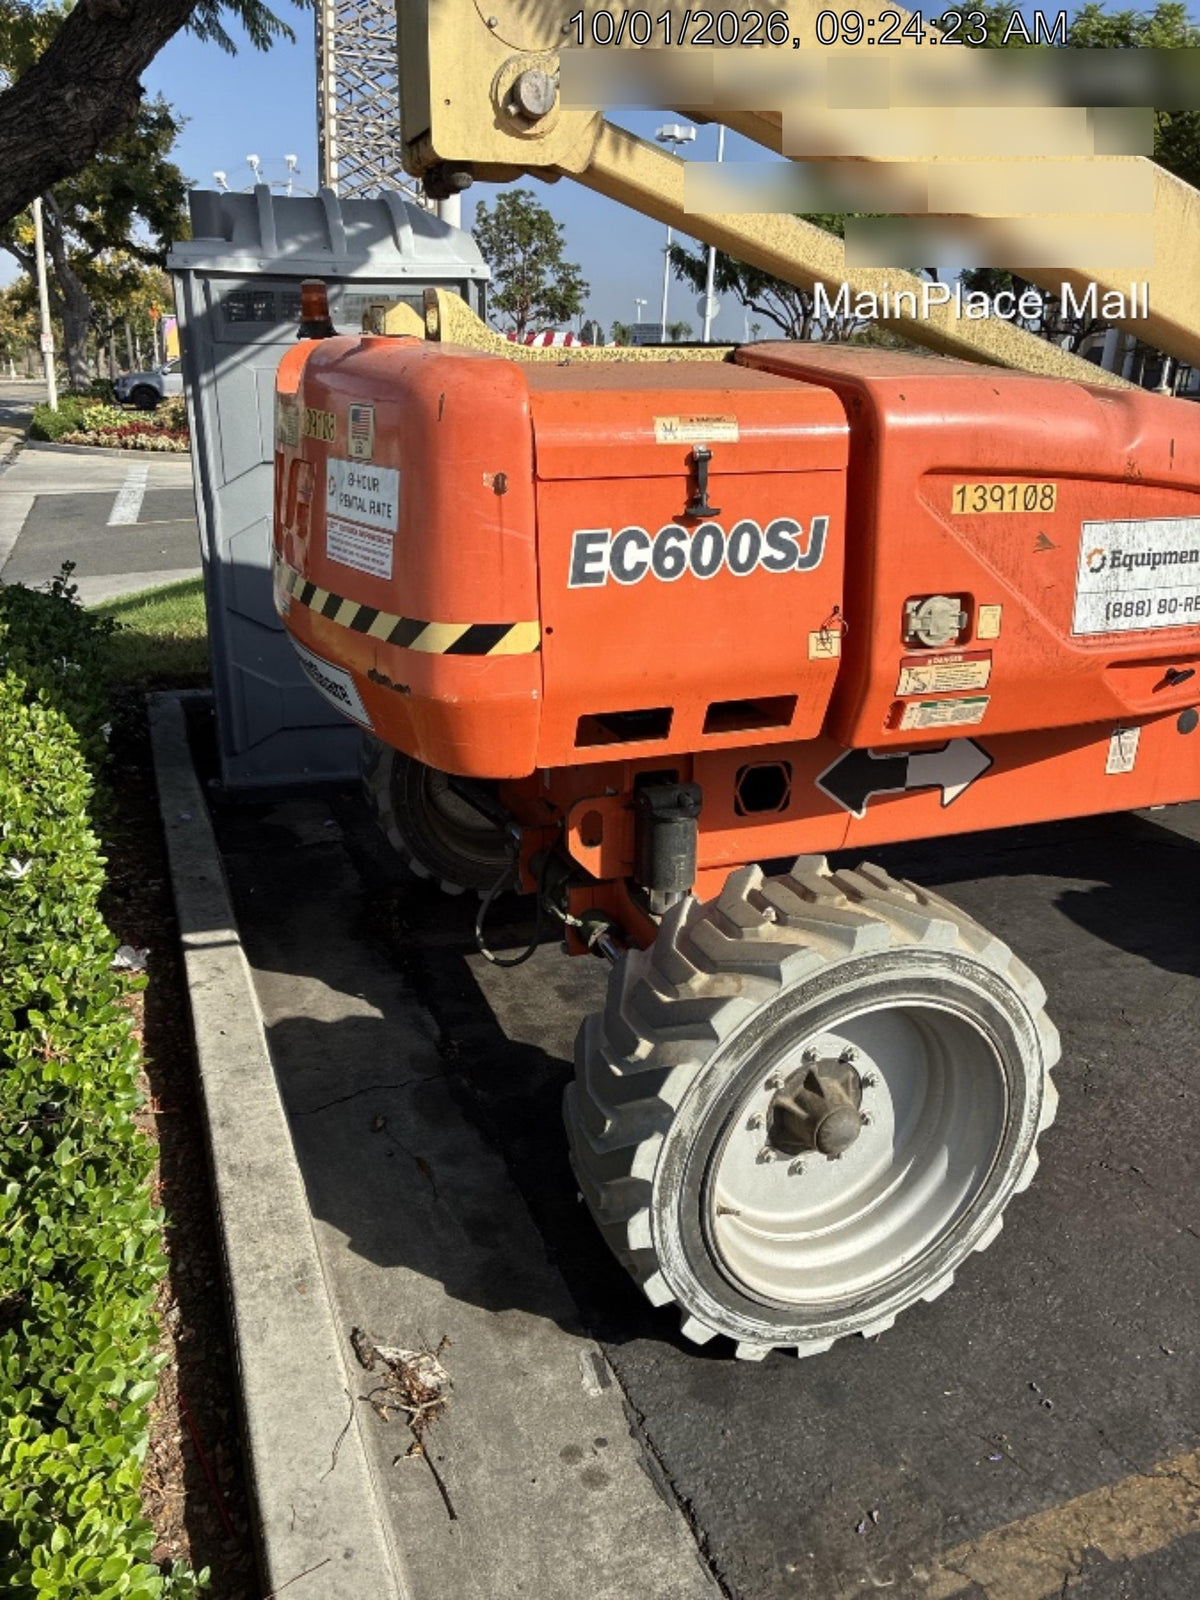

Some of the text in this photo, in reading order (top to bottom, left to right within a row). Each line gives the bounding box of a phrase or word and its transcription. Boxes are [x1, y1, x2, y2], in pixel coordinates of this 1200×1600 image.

[369, 499, 393, 519] RATE
[955, 484, 1055, 513] 139108
[566, 515, 830, 589] EC600SJ
[1109, 547, 1200, 572] Equipmen
[1105, 599, 1151, 620] (888)
